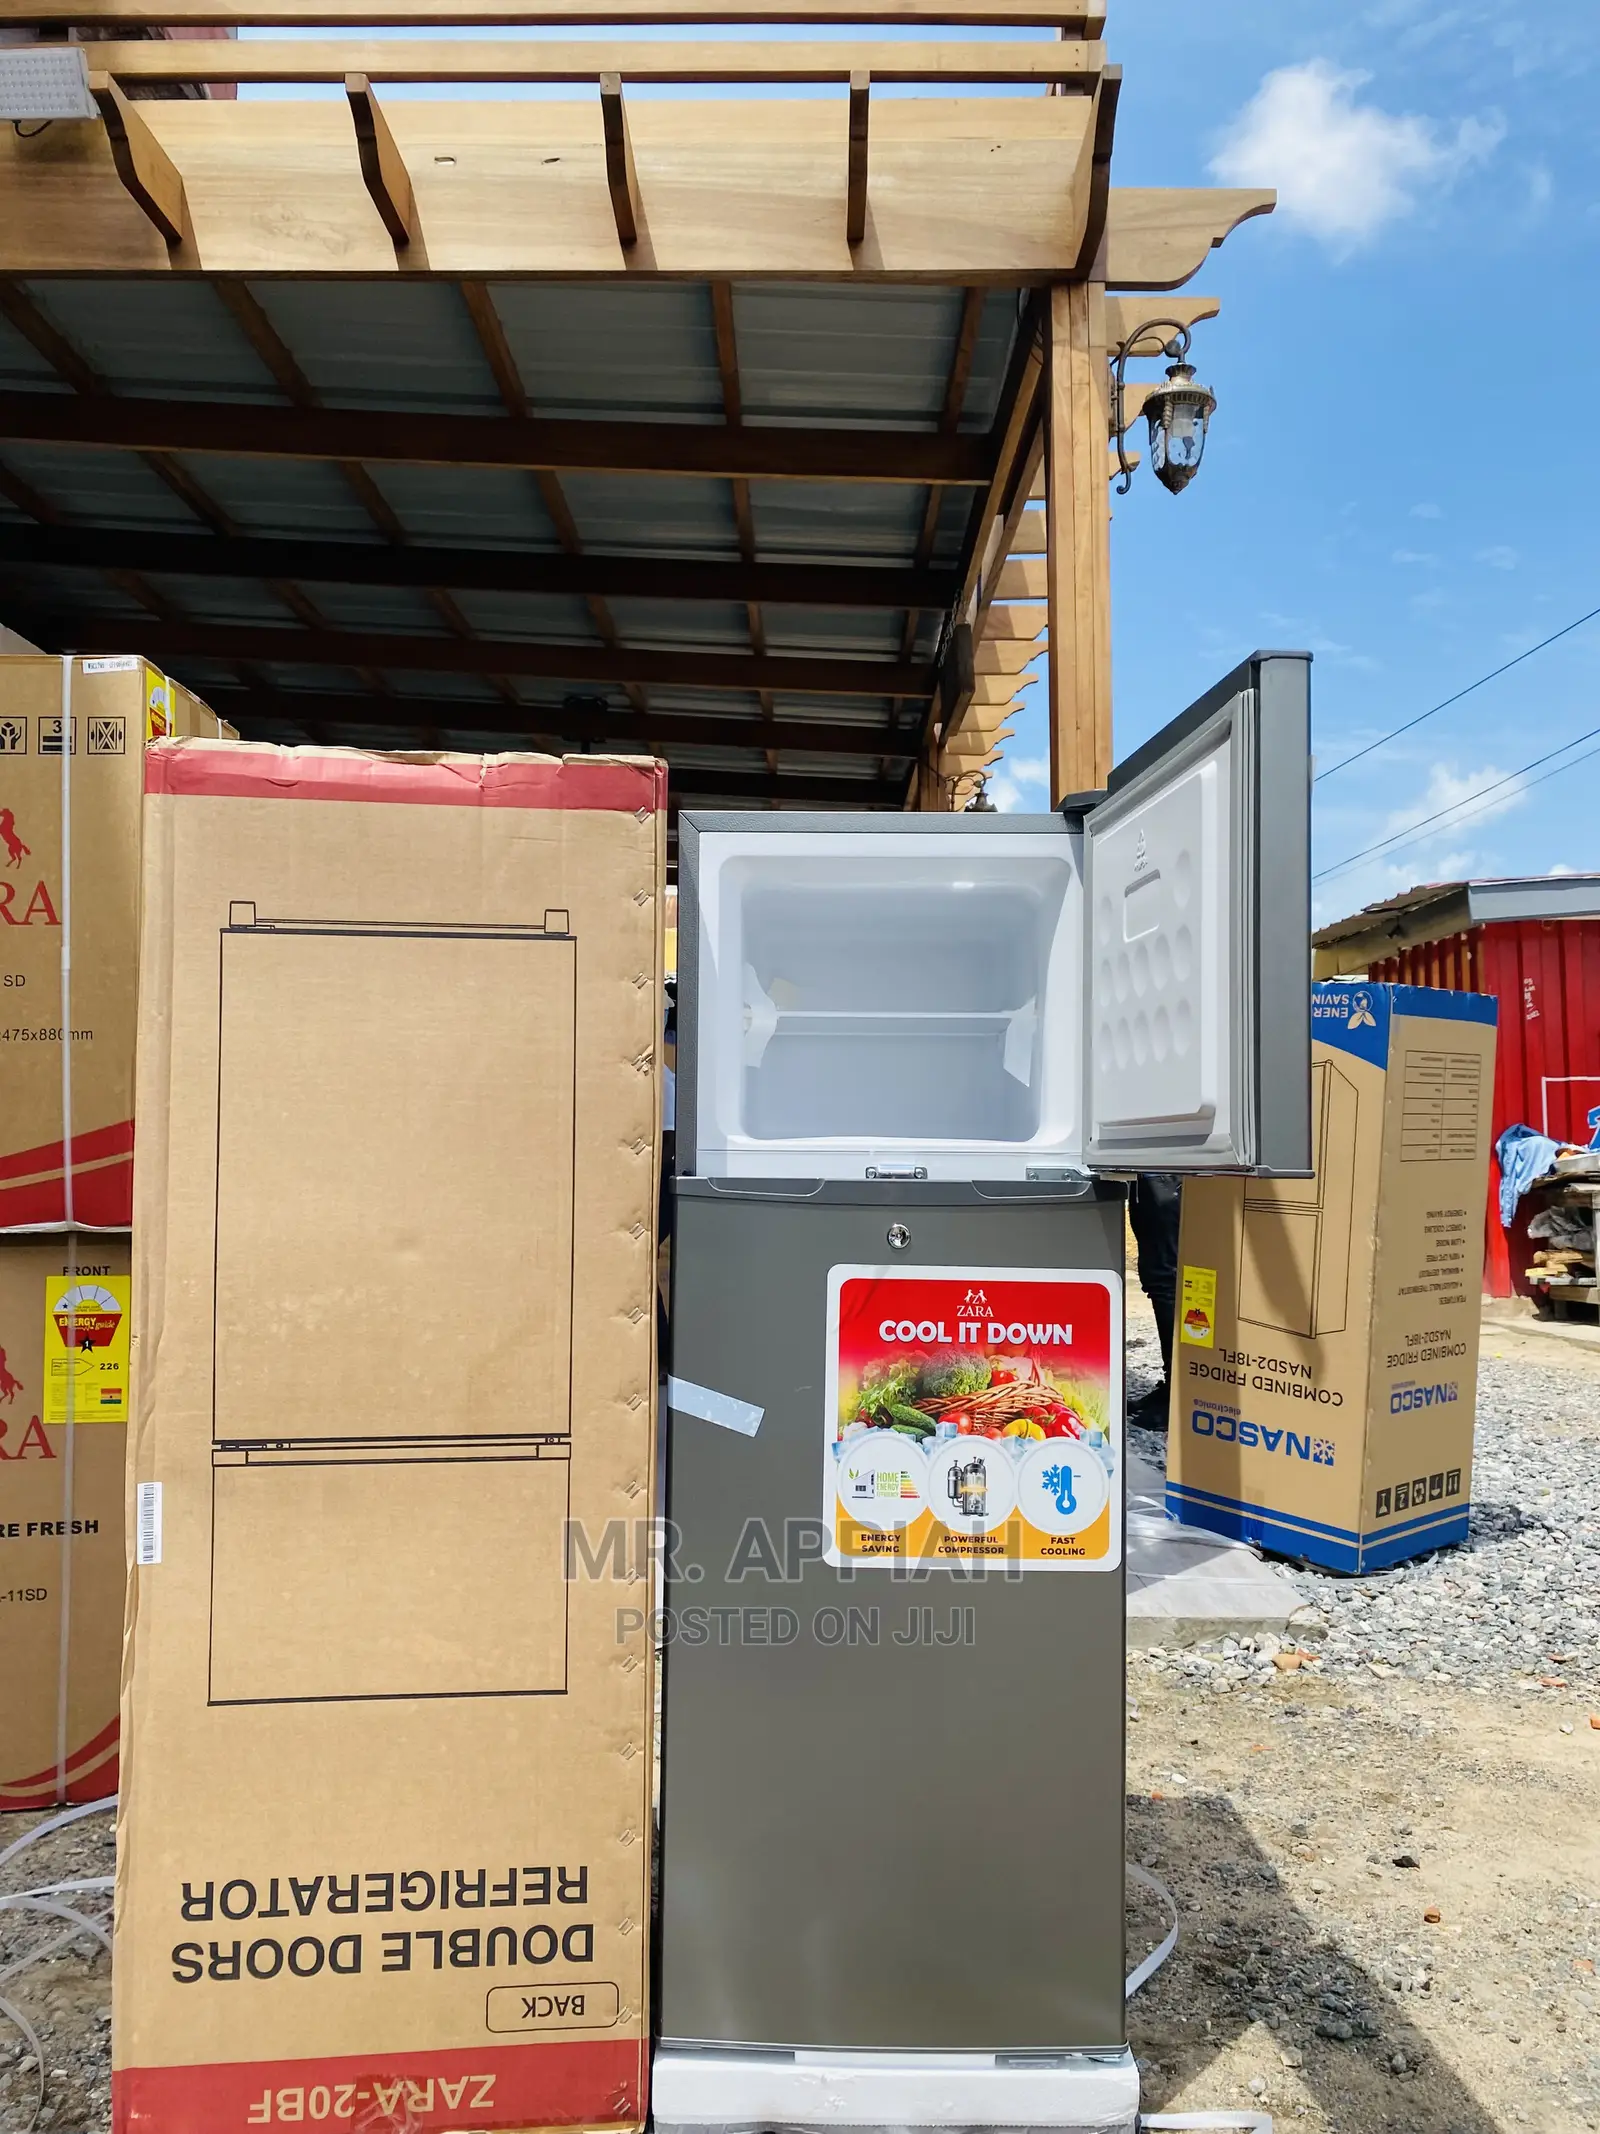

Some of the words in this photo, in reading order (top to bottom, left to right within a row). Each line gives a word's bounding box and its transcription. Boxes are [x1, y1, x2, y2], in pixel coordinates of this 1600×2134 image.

[52, 720, 62, 734] 3
[3, 974, 26, 987] SD
[1312, 1007, 1349, 1018] ENER
[0, 1027, 93, 1041] 475x880mm
[62, 1266, 111, 1276] FRONT
[957, 1305, 994, 1318] ZARA
[879, 1320, 952, 1343] COOL
[959, 1322, 981, 1343] IT
[987, 1322, 1073, 1345] DOWN
[1387, 1351, 1419, 1368] FRIDGE
[1420, 1343, 1467, 1361] COMBINED
[1218, 1348, 1312, 1379] NASD2-18FL
[1189, 1361, 1247, 1386] FRIDGE
[1252, 1375, 1344, 1407] COMBINED
[1390, 1383, 1447, 1414] NASCO
[1193, 1398, 1242, 1416] electronics
[1192, 1410, 1311, 1461] NASCO
[876, 1471, 899, 1483] HOME
[27, 1520, 99, 1536] FRESH
[861, 1533, 901, 1543] ENERGY
[944, 1536, 998, 1544] POWERFUL
[1050, 1537, 1076, 1545] FAST
[861, 1545, 900, 1553] SAVING
[938, 1546, 1004, 1555] COMPRESSOR
[1040, 1547, 1086, 1556] COOLING
[0, 1588, 48, 1602] -11SD
[180, 1865, 588, 1922] REFRIGERATOR
[381, 1923, 595, 1973] DOUBLE
[171, 1933, 362, 1984] DOORS
[521, 1994, 586, 2019] BACK
[247, 2074, 497, 2124] ZARA-20BF
